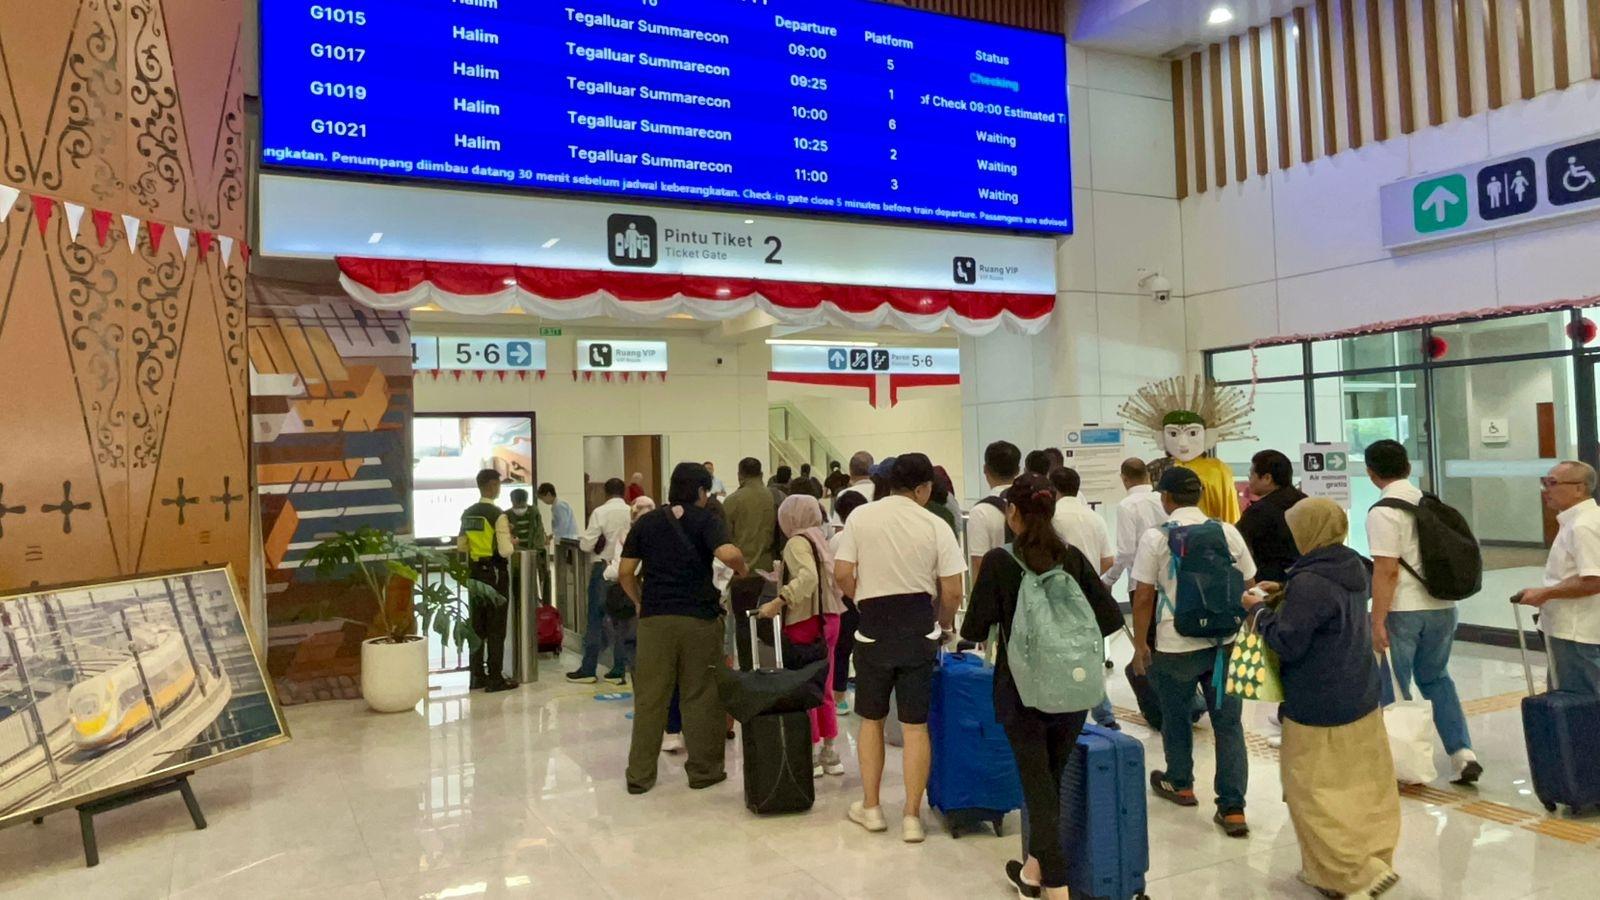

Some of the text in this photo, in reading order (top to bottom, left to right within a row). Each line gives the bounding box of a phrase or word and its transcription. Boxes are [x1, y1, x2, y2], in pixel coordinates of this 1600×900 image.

[310, 5, 366, 25] G1015
[565, 8, 729, 44] Tegalluar Summarecon
[775, 15, 837, 36] Departure
[453, 26, 498, 44] Halim
[865, 31, 913, 49] Platform
[310, 43, 365, 62] G1017
[566, 42, 730, 76] Tegalluar Summarecon
[789, 43, 827, 59] 09:00
[976, 50, 1009, 65] Status
[454, 62, 499, 79] Halim
[887, 59, 894, 70] 5
[310, 81, 366, 99] G1019
[790, 75, 827, 90] 09:25
[567, 77, 730, 108] Tegalluar Summarecon
[888, 89, 893, 99] 1
[454, 98, 500, 115] Halim
[792, 106, 828, 121] 10:00
[933, 96, 967, 110] Check
[970, 101, 1002, 115] 09:00
[1004, 106, 1055, 123] Estimated
[311, 119, 366, 137] G1021
[568, 111, 731, 140] Tegalluar Summarecon
[889, 119, 896, 130] 6
[455, 134, 500, 151] Halim
[794, 137, 828, 152] 10:25
[976, 131, 1016, 148] Waiting
[568, 145, 732, 173] Tegalluar Summarecon
[890, 149, 897, 160] 2
[795, 169, 828, 182] 11:00
[977, 160, 1017, 176] Waiting
[264, 147, 327, 161] ngkatan.
[332, 152, 413, 171] Penumpang
[416, 160, 468, 173] diimbau
[472, 165, 515, 181] datang
[519, 169, 532, 179] 30
[573, 175, 620, 187] sebelum
[623, 178, 658, 190] jadwal
[661, 182, 740, 197] keberangkatan.
[743, 189, 785, 202] Check-in
[845, 201, 881, 211] minutes
[883, 203, 911, 214] before
[914, 206, 934, 215] train
[935, 208, 977, 219] departure.
[891, 179, 898, 190] 3
[978, 188, 1018, 204] Waiting
[664, 229, 783, 265] Pintu Tiket 2
[665, 247, 728, 261] Ticket Gate
[979, 264, 1019, 275] Ruang VIP
[615, 349, 641, 358] Ruang
[1325, 481, 1348, 489] gratis
